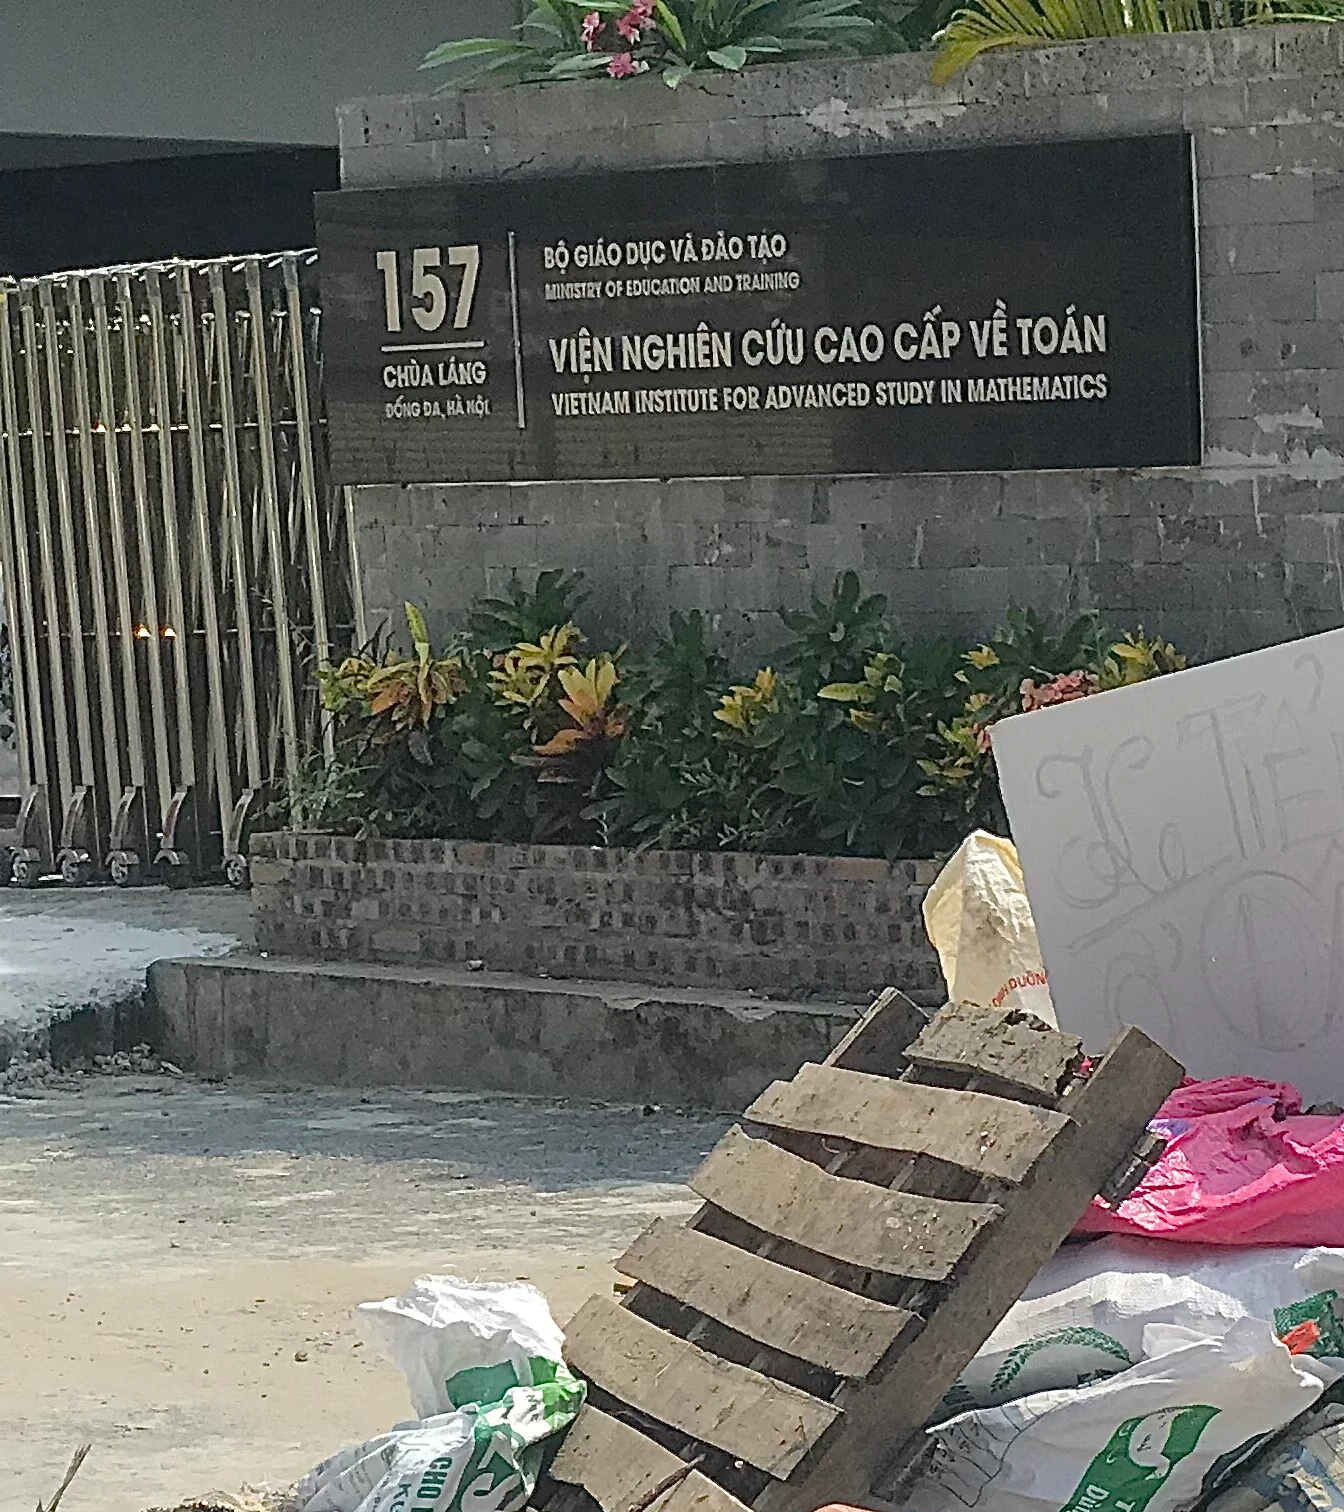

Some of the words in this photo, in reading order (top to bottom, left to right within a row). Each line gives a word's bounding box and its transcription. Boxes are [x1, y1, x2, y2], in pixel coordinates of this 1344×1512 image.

[544, 238, 570, 274] BỘ
[574, 237, 622, 267] GIÁO
[626, 240, 666, 271] DỤC
[670, 232, 698, 263] VÀ
[701, 230, 744, 260] ĐÀO
[747, 233, 788, 265] TẠO
[377, 245, 479, 332] 157
[545, 281, 602, 300] MINISTRY
[605, 280, 624, 297] OF
[626, 276, 700, 298] EDUCATION
[704, 274, 733, 294] AND
[736, 271, 800, 291] TRAINING
[549, 326, 613, 384] VIỆN
[622, 321, 733, 370] NGHIÊN
[741, 317, 804, 366] CỨU
[814, 323, 885, 363] CAO
[894, 304, 961, 360] CẤP
[969, 298, 1009, 357] VỀ
[1016, 303, 1107, 355] TOÁN
[383, 359, 434, 388] CHÙA
[438, 356, 487, 386] LÁNG
[552, 389, 631, 416] VIETNAM
[635, 388, 719, 414] INSTITUTE
[723, 386, 760, 410] FOR
[765, 382, 870, 410] ADVANCED
[875, 380, 936, 406] STUDY
[941, 379, 962, 403] IN
[967, 373, 1107, 402] MATHEMATICS
[414, 1450, 454, 1504] CHO
